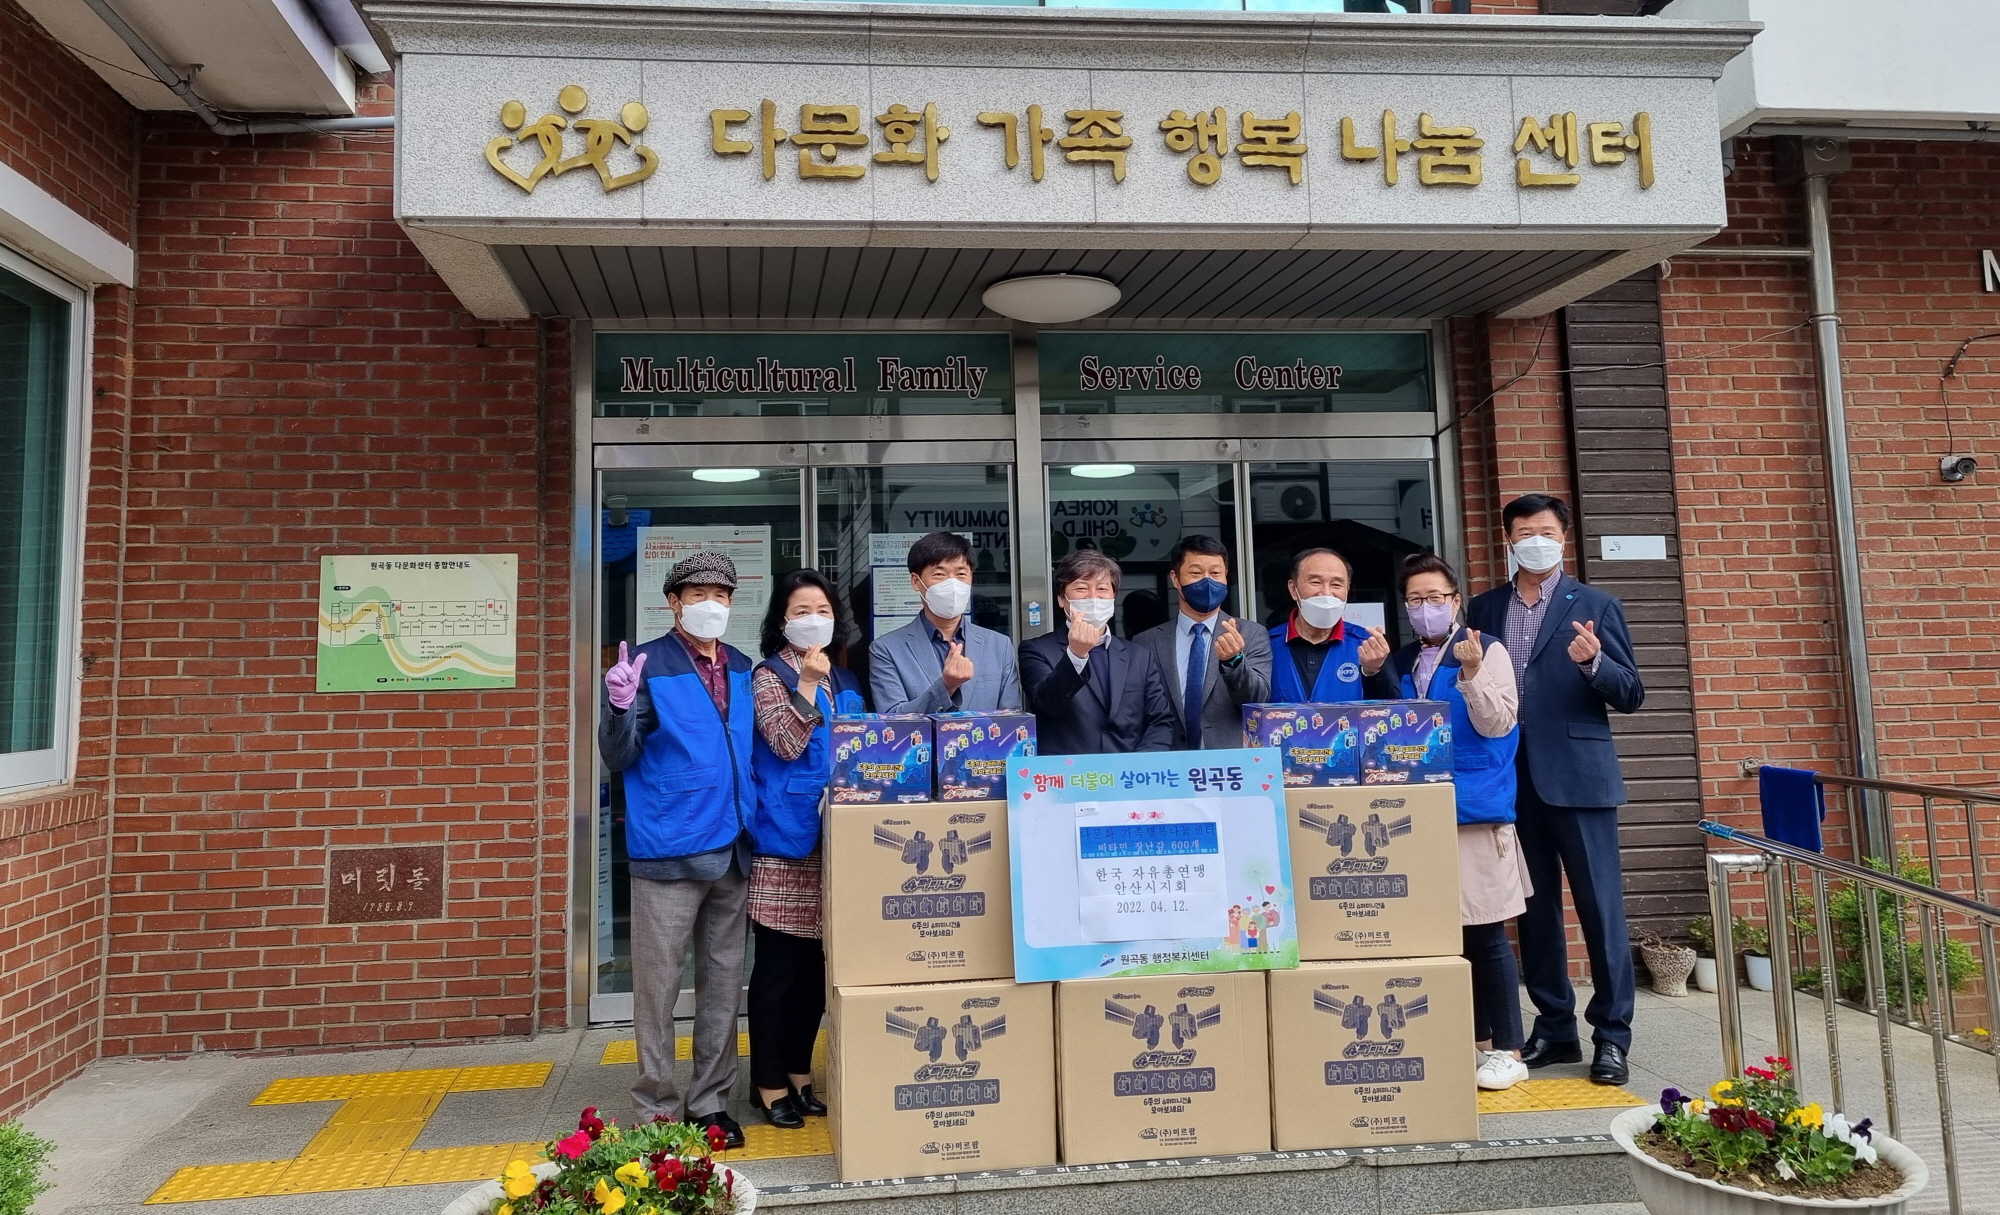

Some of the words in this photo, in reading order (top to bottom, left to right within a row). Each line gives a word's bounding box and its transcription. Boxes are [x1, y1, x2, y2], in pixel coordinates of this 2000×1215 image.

[709, 98, 950, 182] 다문화
[976, 103, 1133, 185] 가족
[1159, 106, 1307, 186] 행복
[1340, 108, 1485, 187] 나눔
[1513, 110, 1654, 189] 센터
[620, 356, 857, 393] Multicultural
[877, 356, 988, 400] Family
[1080, 354, 1202, 391] Service
[1234, 355, 1343, 391] Center
[370, 562, 393, 571] 원곡동
[394, 561, 432, 570] 다문화센터
[433, 560, 471, 569] 종합안내도
[1033, 773, 1064, 793] 함께
[1070, 771, 1115, 791] 더불어
[1120, 769, 1181, 789] 살아가는
[1187, 766, 1244, 792] 원곡동
[1080, 827, 1115, 840] 다문화
[1098, 842, 1128, 853] 비타민
[1134, 841, 1165, 852] 장난감
[1171, 839, 1200, 850] 600개
[341, 862, 430, 894] 머릿돌
[1095, 867, 1123, 881] 한국
[1132, 864, 1206, 879] 자유총연맹
[1114, 879, 1188, 896] 안산시지회
[1117, 901, 1146, 914] 2022.
[1150, 901, 1167, 913] 04.
[1173, 901, 1189, 912] 12.
[1120, 953, 1149, 965] 원곡동
[1152, 951, 1209, 964] 행정복지센터
